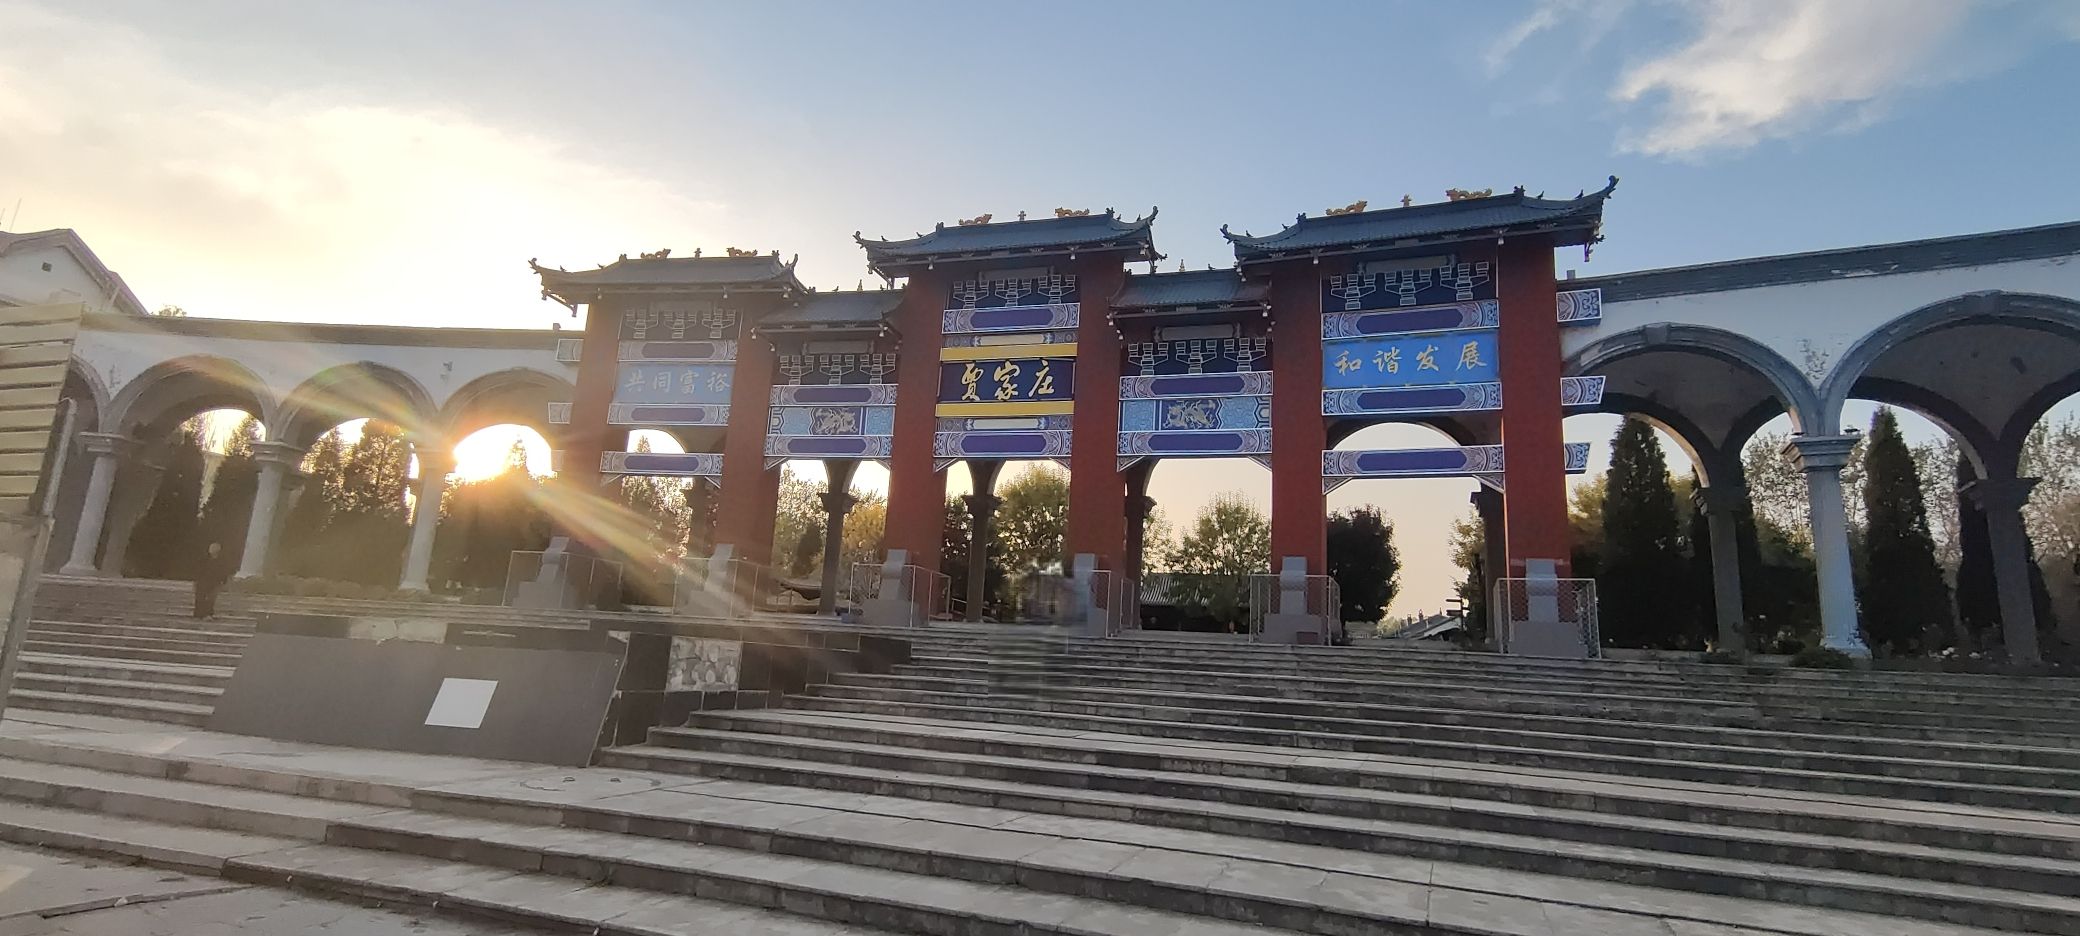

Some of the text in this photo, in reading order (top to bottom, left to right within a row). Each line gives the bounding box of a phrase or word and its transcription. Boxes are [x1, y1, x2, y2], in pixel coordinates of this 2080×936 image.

[1333, 340, 1487, 376] 和谐发展
[624, 369, 731, 394] 共同富裕
